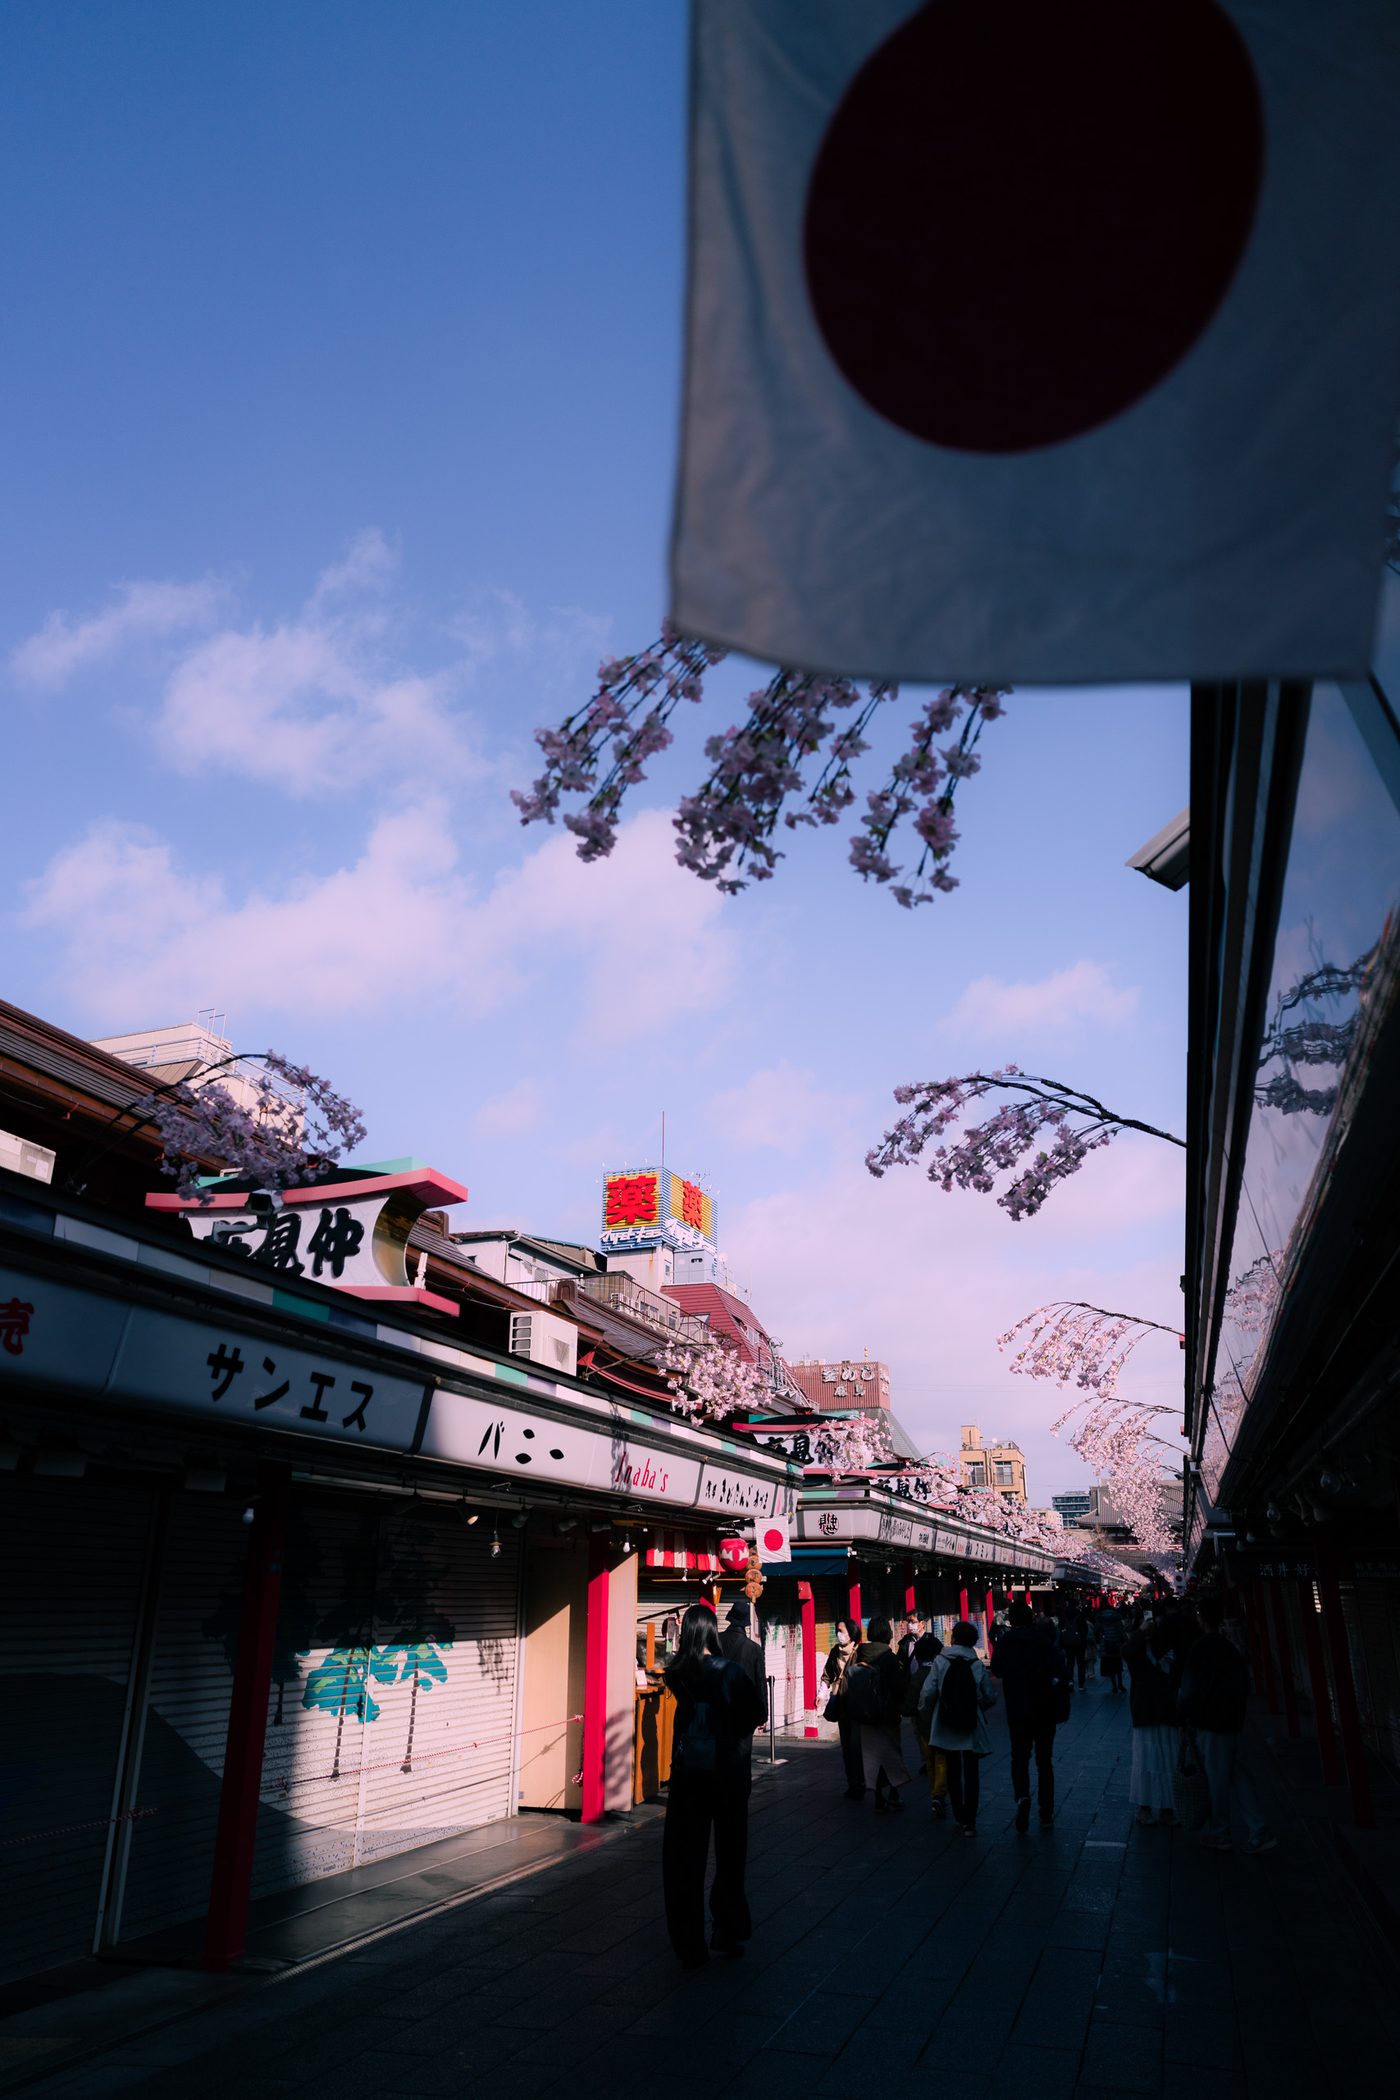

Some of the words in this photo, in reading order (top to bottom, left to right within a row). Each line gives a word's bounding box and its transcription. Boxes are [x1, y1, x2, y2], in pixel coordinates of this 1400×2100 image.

[606, 1175, 657, 1225] 薬
[682, 1181, 703, 1230] 薬
[206, 1343, 374, 1432] サンエス
[822, 1365, 875, 1383] 釜めし
[615, 1451, 669, 1493] Inaba's
